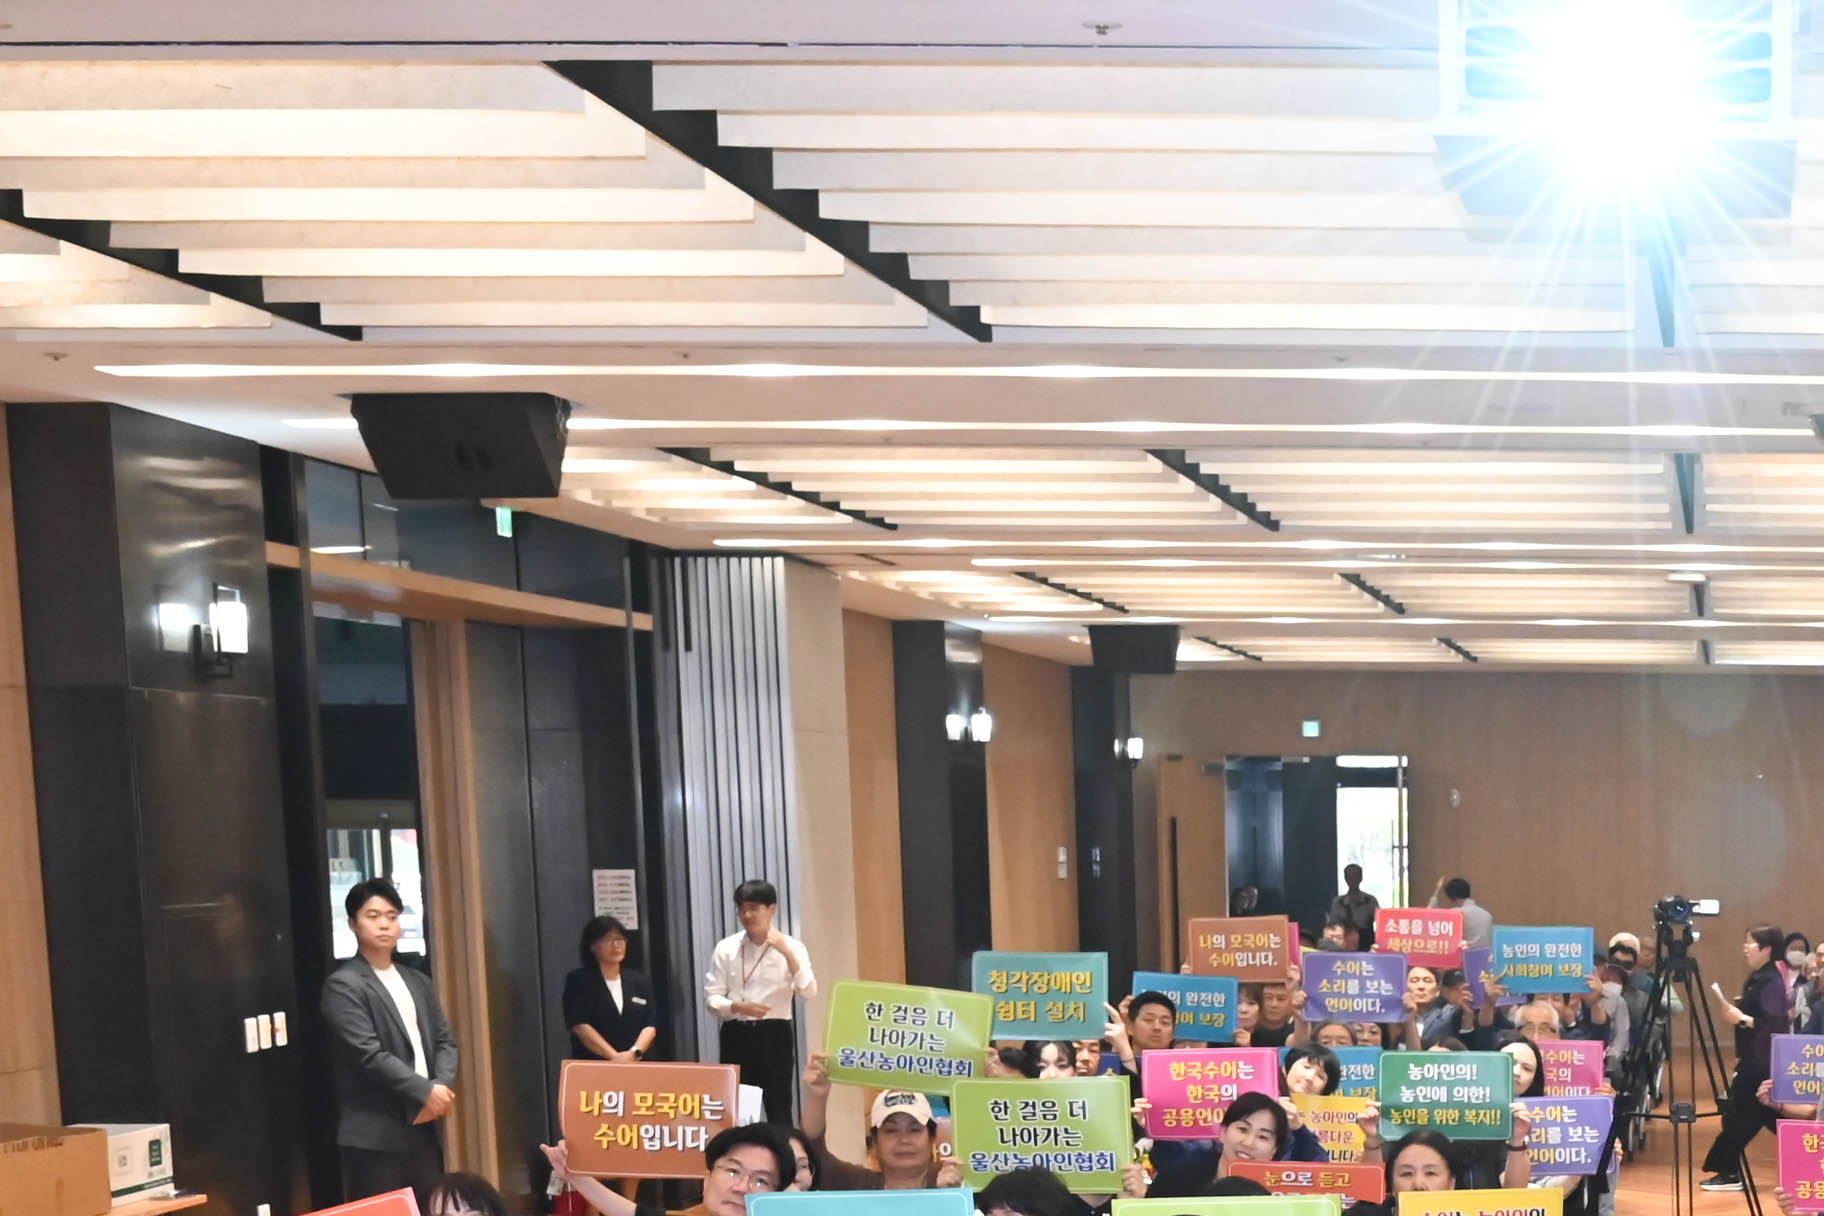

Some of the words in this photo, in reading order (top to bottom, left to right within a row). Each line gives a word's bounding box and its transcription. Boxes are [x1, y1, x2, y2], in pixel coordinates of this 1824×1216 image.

[1384, 919, 1424, 935] 소통을
[1428, 920, 1454, 935] 넘어
[1199, 933, 1225, 949] 나의
[1230, 932, 1281, 949] 모국어는
[1386, 938, 1449, 956] 세상으로!!
[1209, 953, 1278, 967] 수어입니다.
[1502, 943, 1541, 959] 농인의
[1545, 943, 1583, 959] 완전한
[1332, 960, 1375, 976] 수어는
[988, 969, 1093, 995] 청각장애인
[1318, 979, 1360, 994] 소리를
[1365, 979, 1393, 995] 보는
[1186, 991, 1225, 1007] 완전한
[1325, 998, 1386, 1013] 언어이다.
[866, 1001, 885, 1023] 한
[891, 1004, 929, 1027] 걸음
[936, 1007, 956, 1030] 더
[997, 1000, 1036, 1023] 쉼터
[1046, 1000, 1086, 1023] 설치
[869, 1026, 945, 1052] 나아가는
[838, 1048, 973, 1078] 울산농아인협회
[1169, 1060, 1255, 1081] 한국수어는
[1408, 1063, 1477, 1081] 농아인의!
[1186, 1084, 1238, 1104] 한국의
[1400, 1086, 1448, 1104] 농인에
[1453, 1086, 1491, 1104] 의한!
[580, 1090, 625, 1117] 나의
[632, 1092, 725, 1120] 모국어는
[989, 1099, 1010, 1121] 한
[1018, 1100, 1058, 1122] 걸음
[1068, 1099, 1088, 1120] 더
[1531, 1105, 1577, 1123] 수어는
[1390, 1109, 1429, 1125] 농인을
[1434, 1108, 1461, 1125] 위한
[1465, 1108, 1501, 1125] 복지!!
[999, 1127, 1083, 1148] 나아가는
[1568, 1126, 1601, 1143] 보는
[969, 1151, 1116, 1174] 울산농아인협회
[1264, 1171, 1313, 1187] 눈으로
[1319, 1171, 1351, 1187] 듣고
